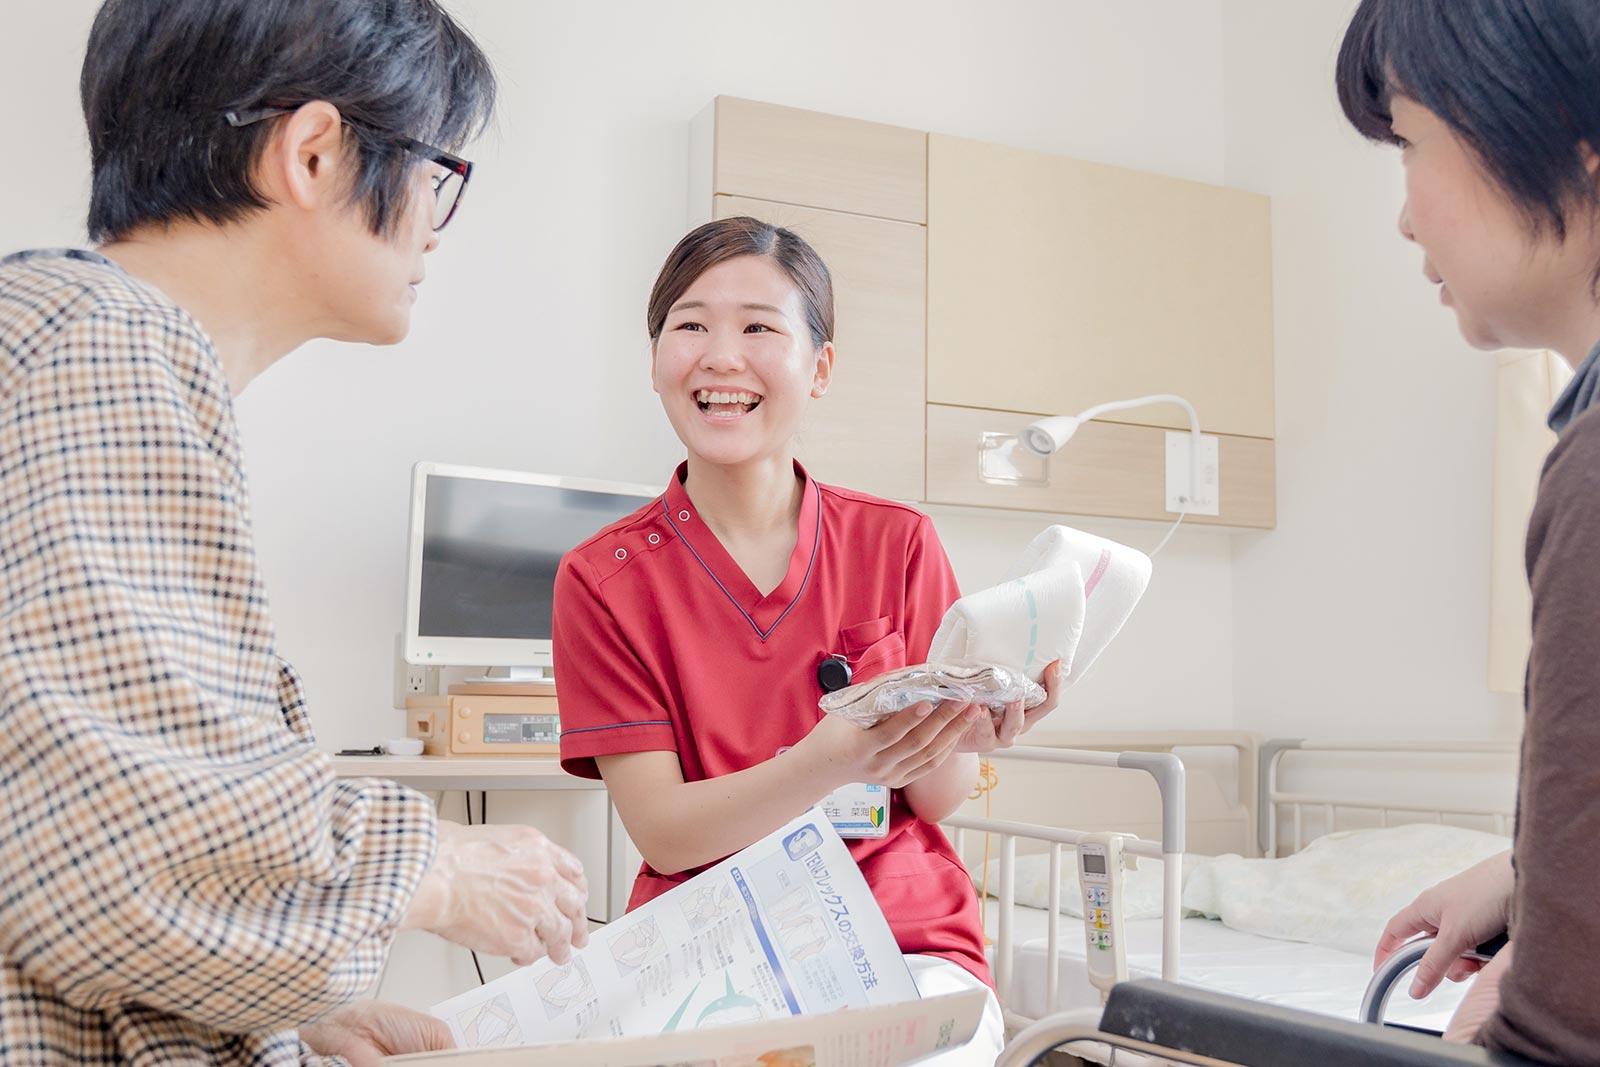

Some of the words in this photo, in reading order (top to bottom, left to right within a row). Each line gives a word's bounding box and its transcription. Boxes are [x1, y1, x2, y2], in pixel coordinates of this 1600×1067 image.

[804, 851, 878, 990] TENAフレックスの交換方法
